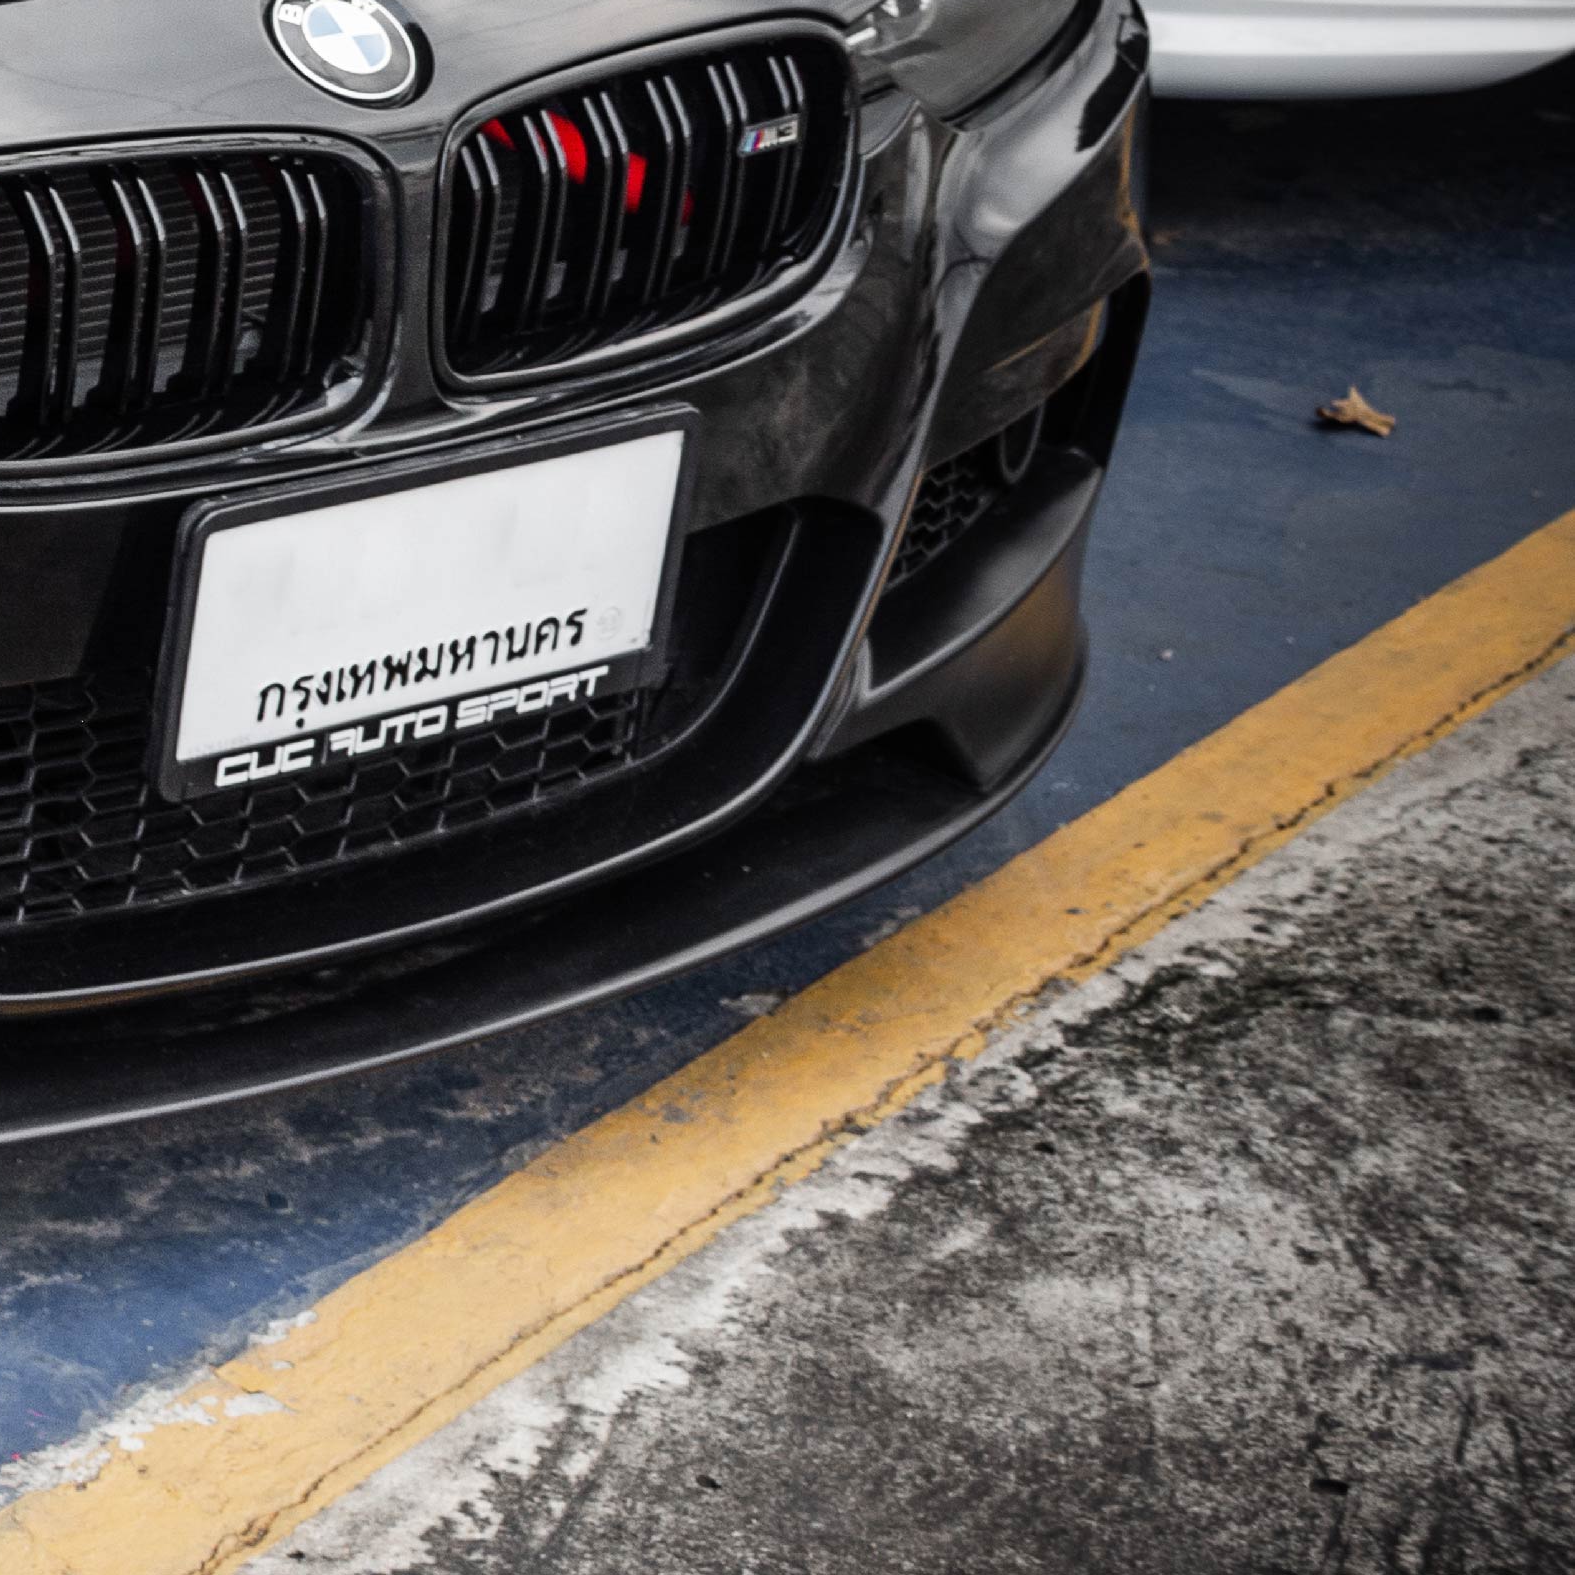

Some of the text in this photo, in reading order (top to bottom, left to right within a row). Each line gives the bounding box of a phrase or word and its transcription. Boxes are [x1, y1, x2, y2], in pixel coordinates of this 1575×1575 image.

[751, 117, 799, 151] M3
[256, 607, 588, 729] กรุงเทพมหานคร
[329, 705, 449, 757] AUTO
[454, 665, 610, 731] SPORT
